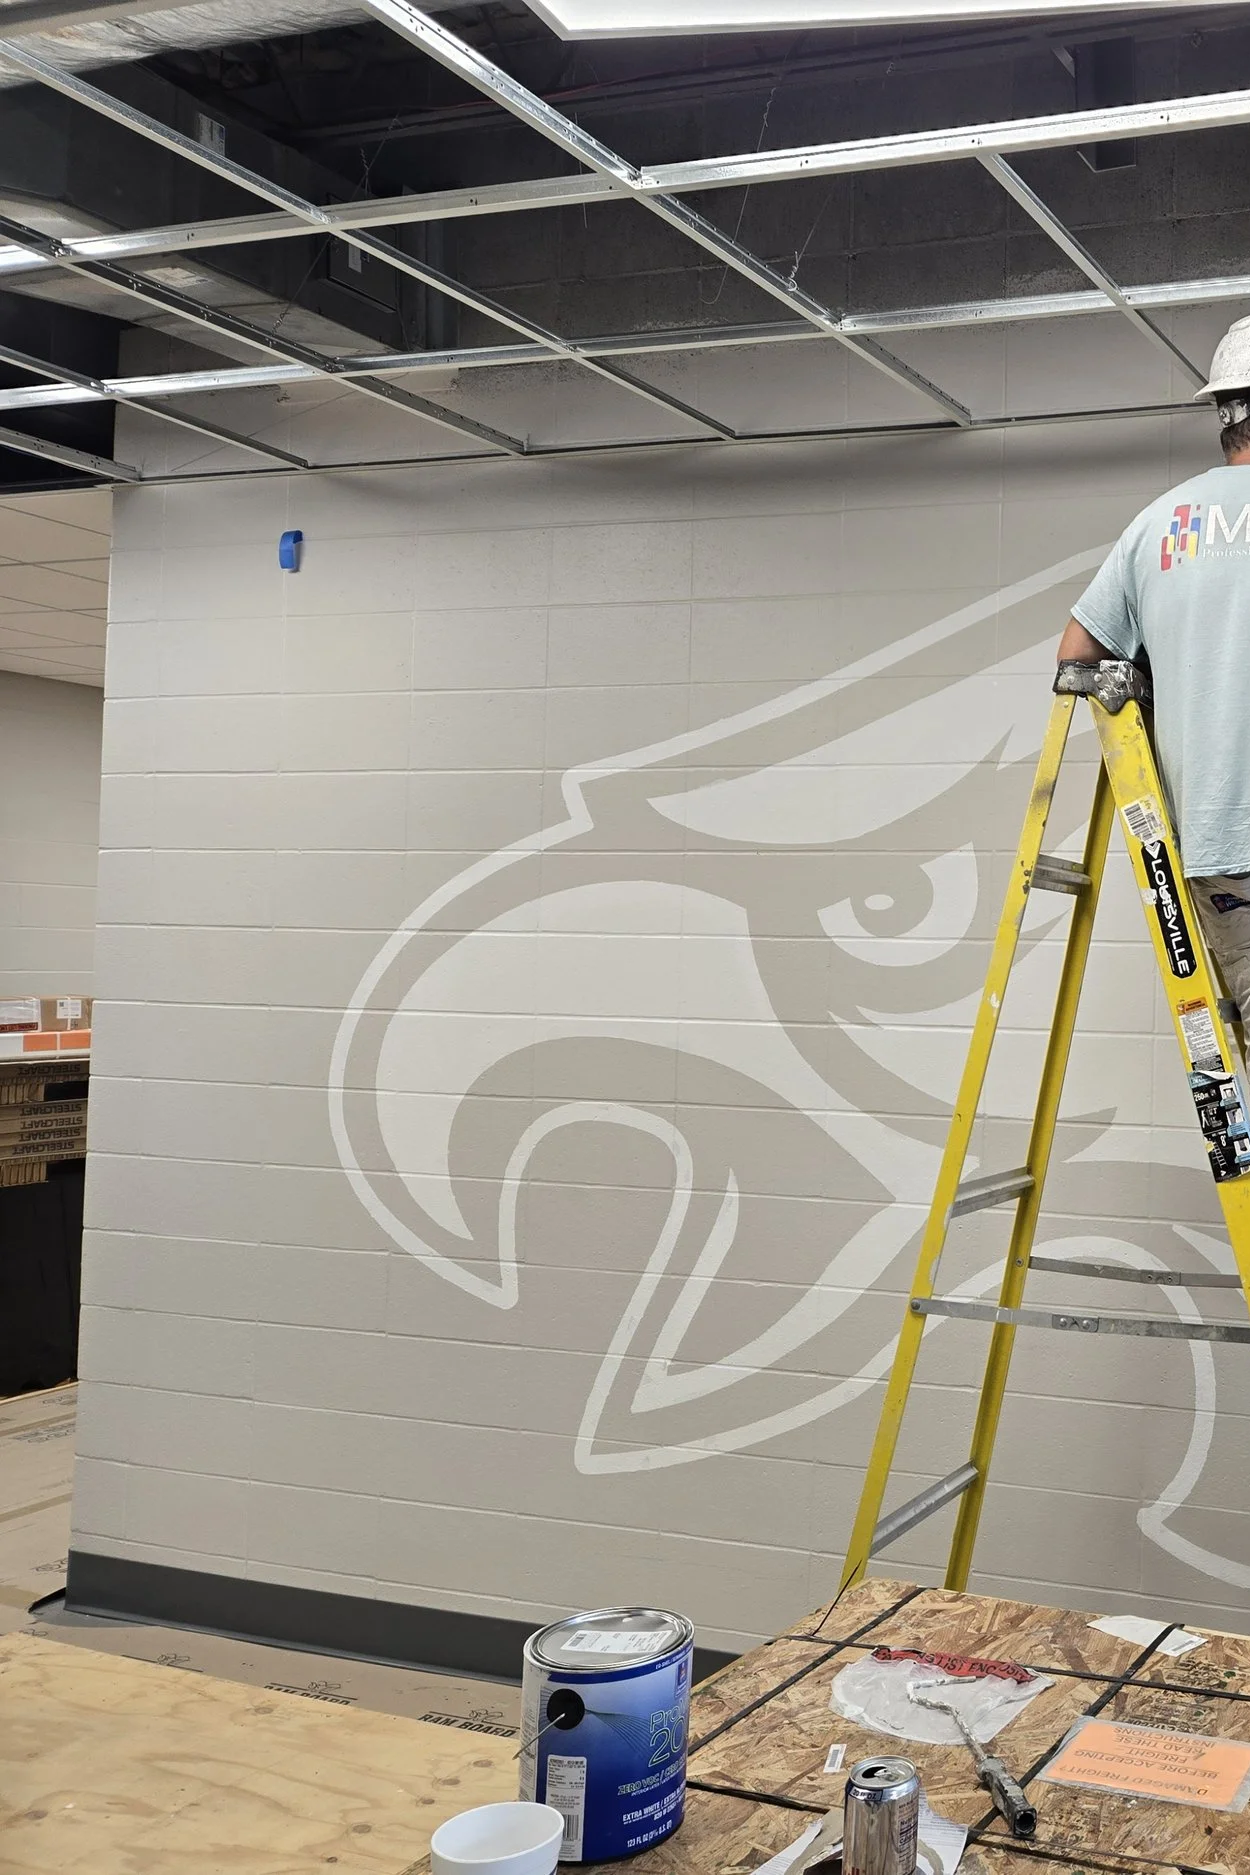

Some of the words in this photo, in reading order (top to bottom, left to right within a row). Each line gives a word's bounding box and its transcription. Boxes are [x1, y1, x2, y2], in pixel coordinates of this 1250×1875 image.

[19, 1103, 82, 1116] STEELCRAFT
[20, 1116, 83, 1130] STEELCRAFT
[19, 1128, 81, 1142] STEELCRAFT
[12, 1140, 75, 1155] STEELCRAFT
[418, 1714, 457, 1726] RAM
[458, 1721, 516, 1738] BOARD
[1113, 1727, 1215, 1748] INSTRUCTIONS
[1113, 1735, 1159, 1749] THESE
[1161, 1742, 1204, 1755] READ
[1075, 1750, 1156, 1770] ACCEPTING
[1127, 1749, 1188, 1764] FREIGHT
[1059, 1764, 1130, 1783] FREIGHT?
[1158, 1764, 1219, 1780] BEFORE
[1132, 1777, 1208, 1797] DAMAGED
[622, 1810, 643, 1822] EXTRA
[643, 1802, 661, 1815] WHITE
